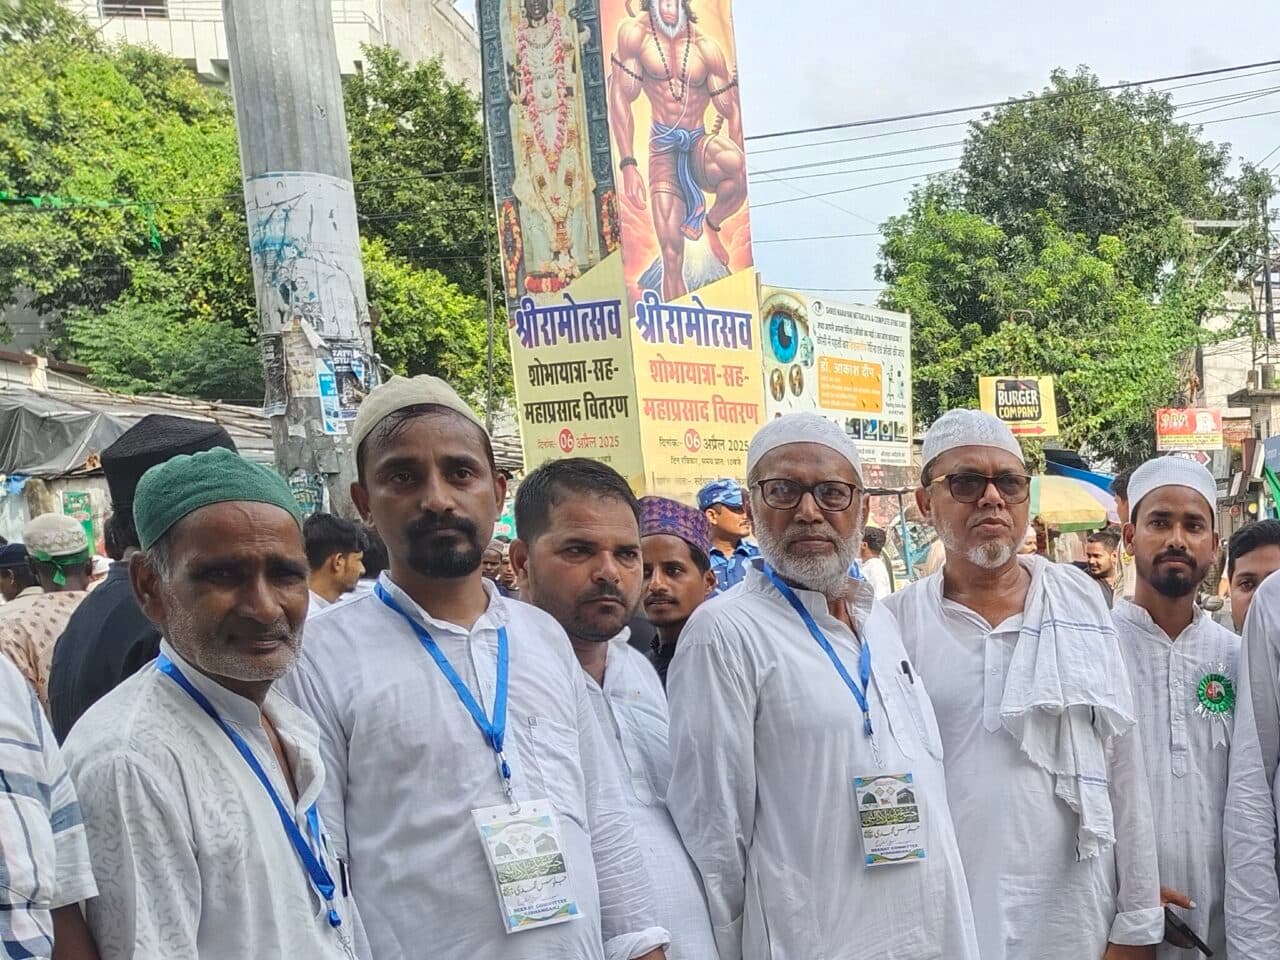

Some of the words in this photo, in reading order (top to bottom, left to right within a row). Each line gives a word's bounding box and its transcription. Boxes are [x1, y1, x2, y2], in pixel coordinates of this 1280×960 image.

[516, 293, 622, 348] श्रीरामोत्सव
[636, 290, 753, 350] श्रीरामोत्सव
[524, 399, 581, 424] महाप्रसाद
[582, 391, 629, 421] वितरण
[997, 390, 1039, 405] BURGER
[643, 398, 709, 422] महाप्रसाद
[712, 394, 759, 424] वितरण
[999, 406, 1040, 418] COMPANY
[599, 436, 620, 448] 2025
[728, 440, 749, 452] 2025
